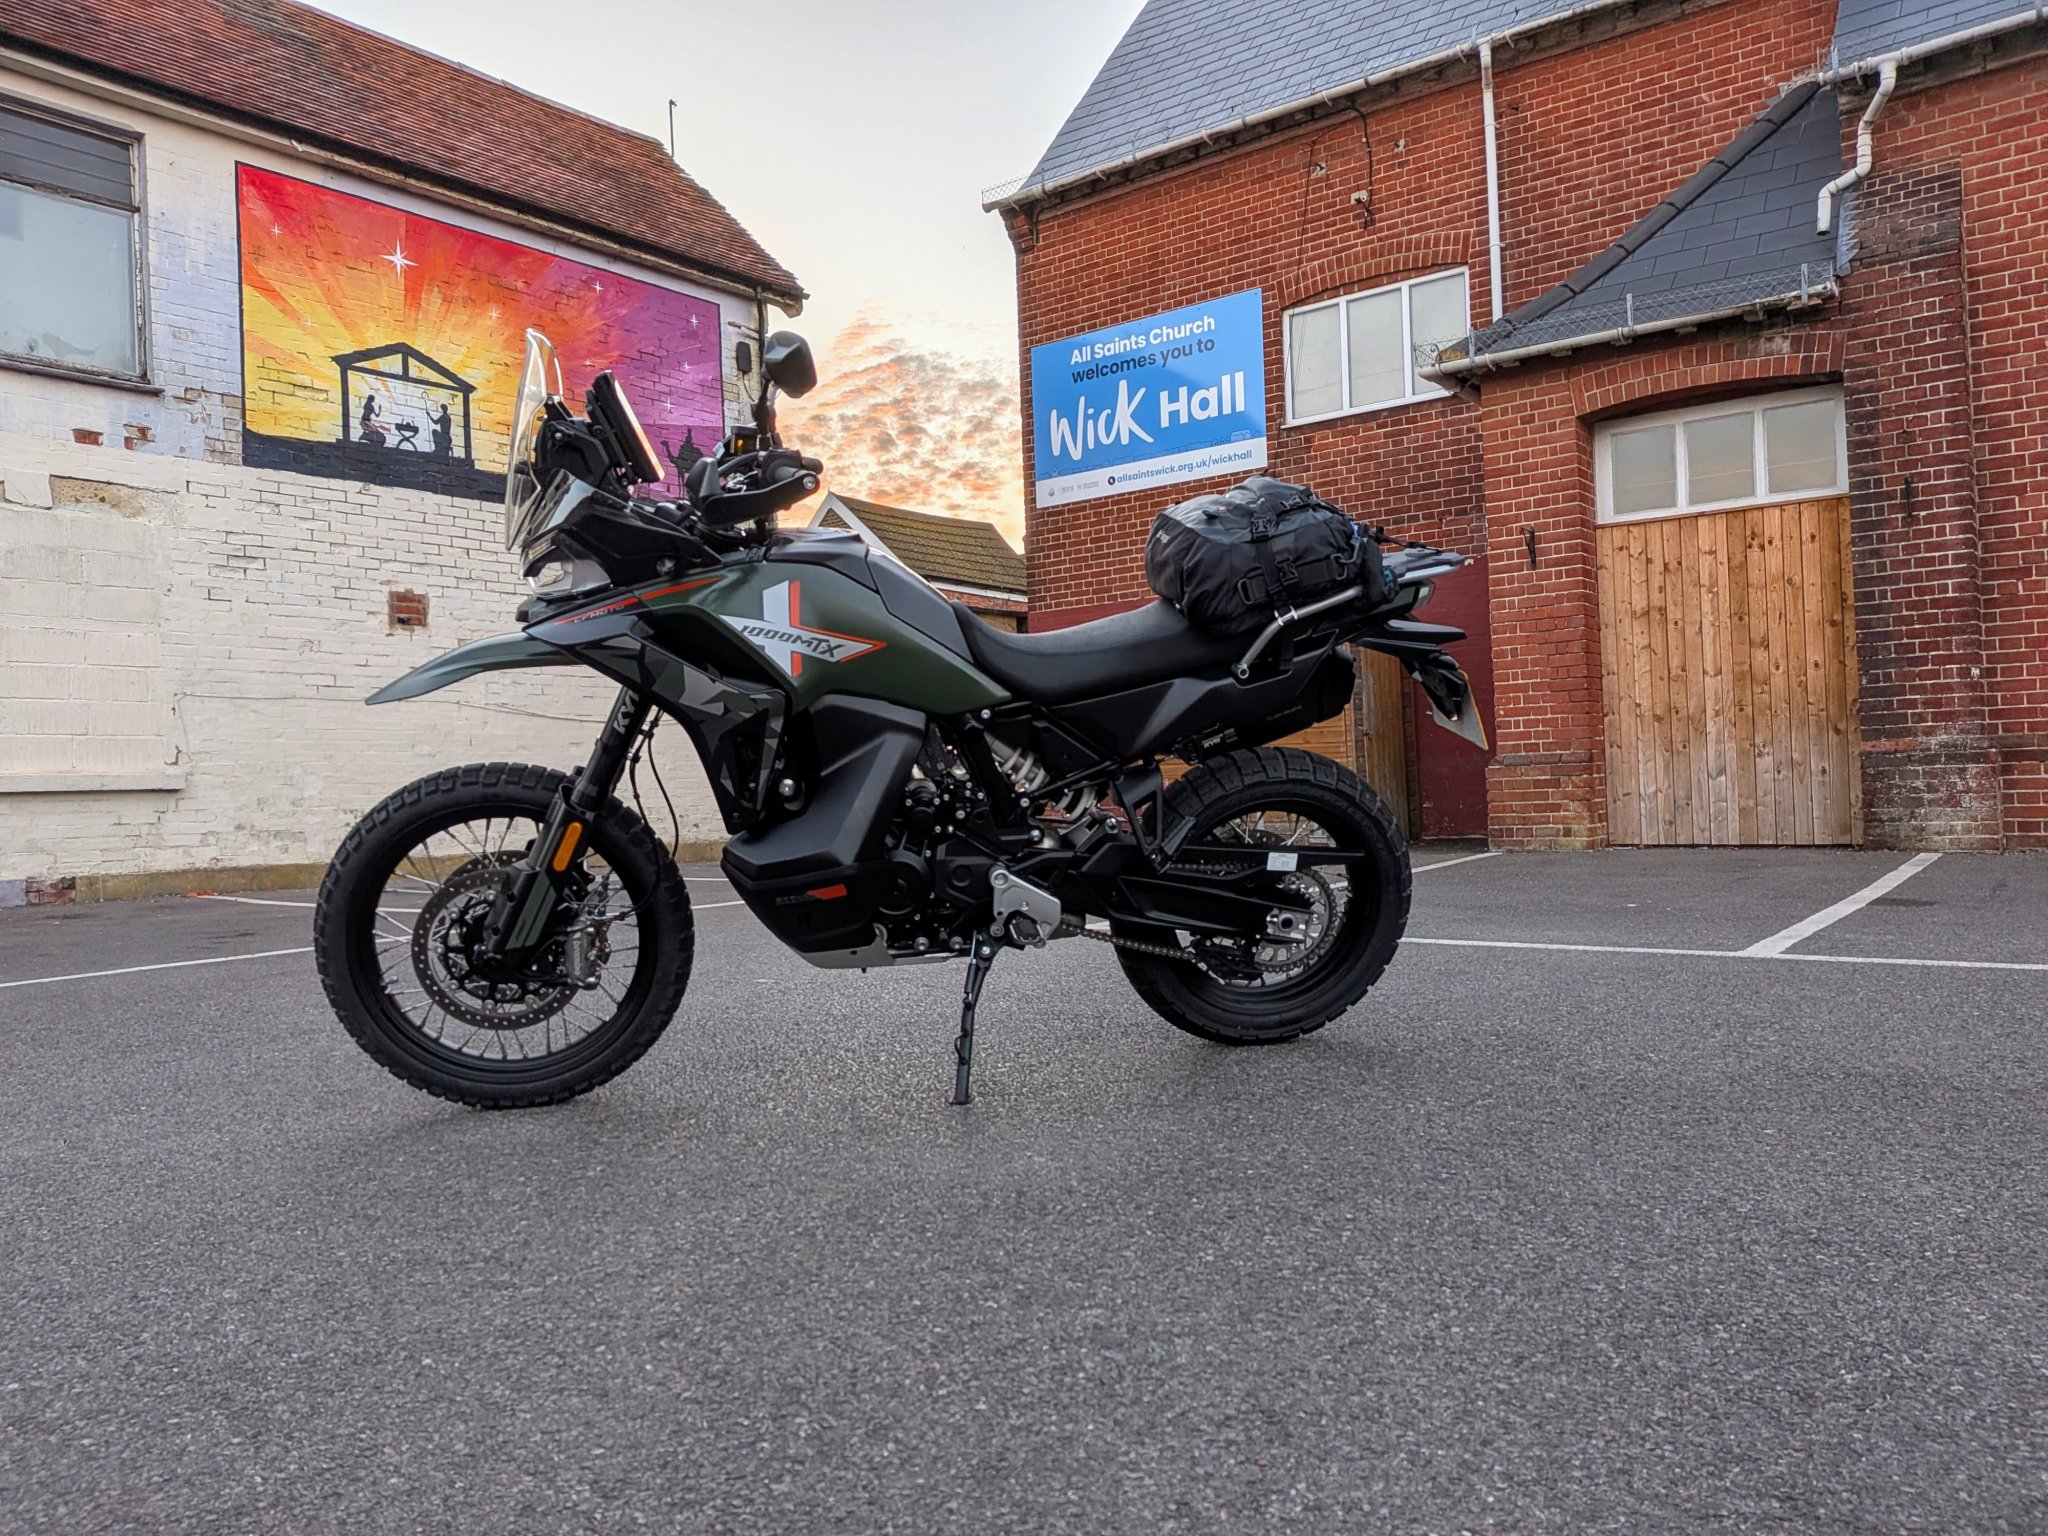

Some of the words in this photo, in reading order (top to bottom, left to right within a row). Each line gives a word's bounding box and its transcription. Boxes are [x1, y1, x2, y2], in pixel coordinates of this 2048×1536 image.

[1071, 345, 1091, 365] All
[1094, 337, 1147, 359] Saints
[1149, 315, 1216, 345] Church
[1071, 353, 1157, 384] welcomes
[1160, 343, 1193, 368] you
[1196, 338, 1215, 353] to
[1050, 379, 1155, 461] Wick
[1159, 371, 1246, 429] Hall
[1116, 450, 1253, 484] allsaintswick.org.uk/wickhall
